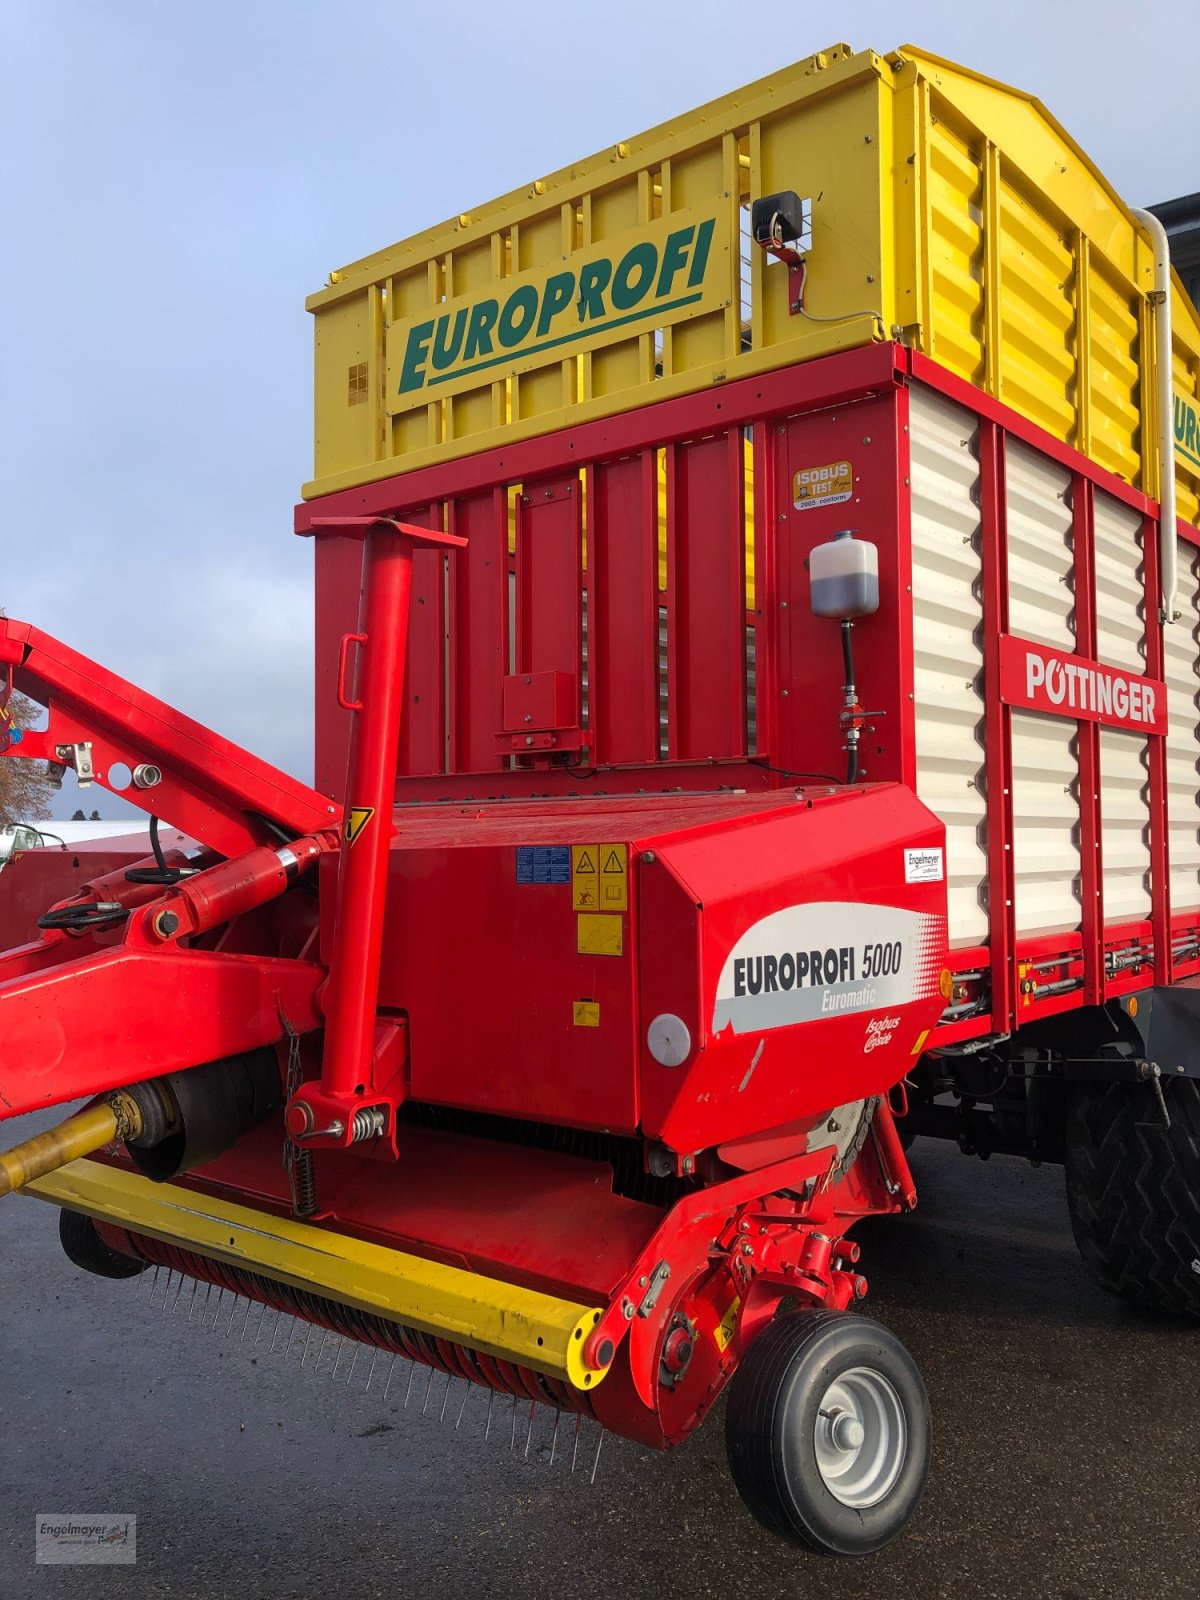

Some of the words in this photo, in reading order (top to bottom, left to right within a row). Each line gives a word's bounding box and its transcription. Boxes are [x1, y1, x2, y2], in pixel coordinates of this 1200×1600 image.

[398, 218, 716, 394] EUROPROFI
[797, 463, 848, 486] ISOBUS
[812, 481, 833, 495] TEST
[909, 851, 940, 868] Engelmayer
[734, 946, 855, 997] EUROPROFI
[862, 941, 902, 978] 5000
[821, 984, 877, 1012] Euromatic
[865, 1016, 901, 1034] Isobus
